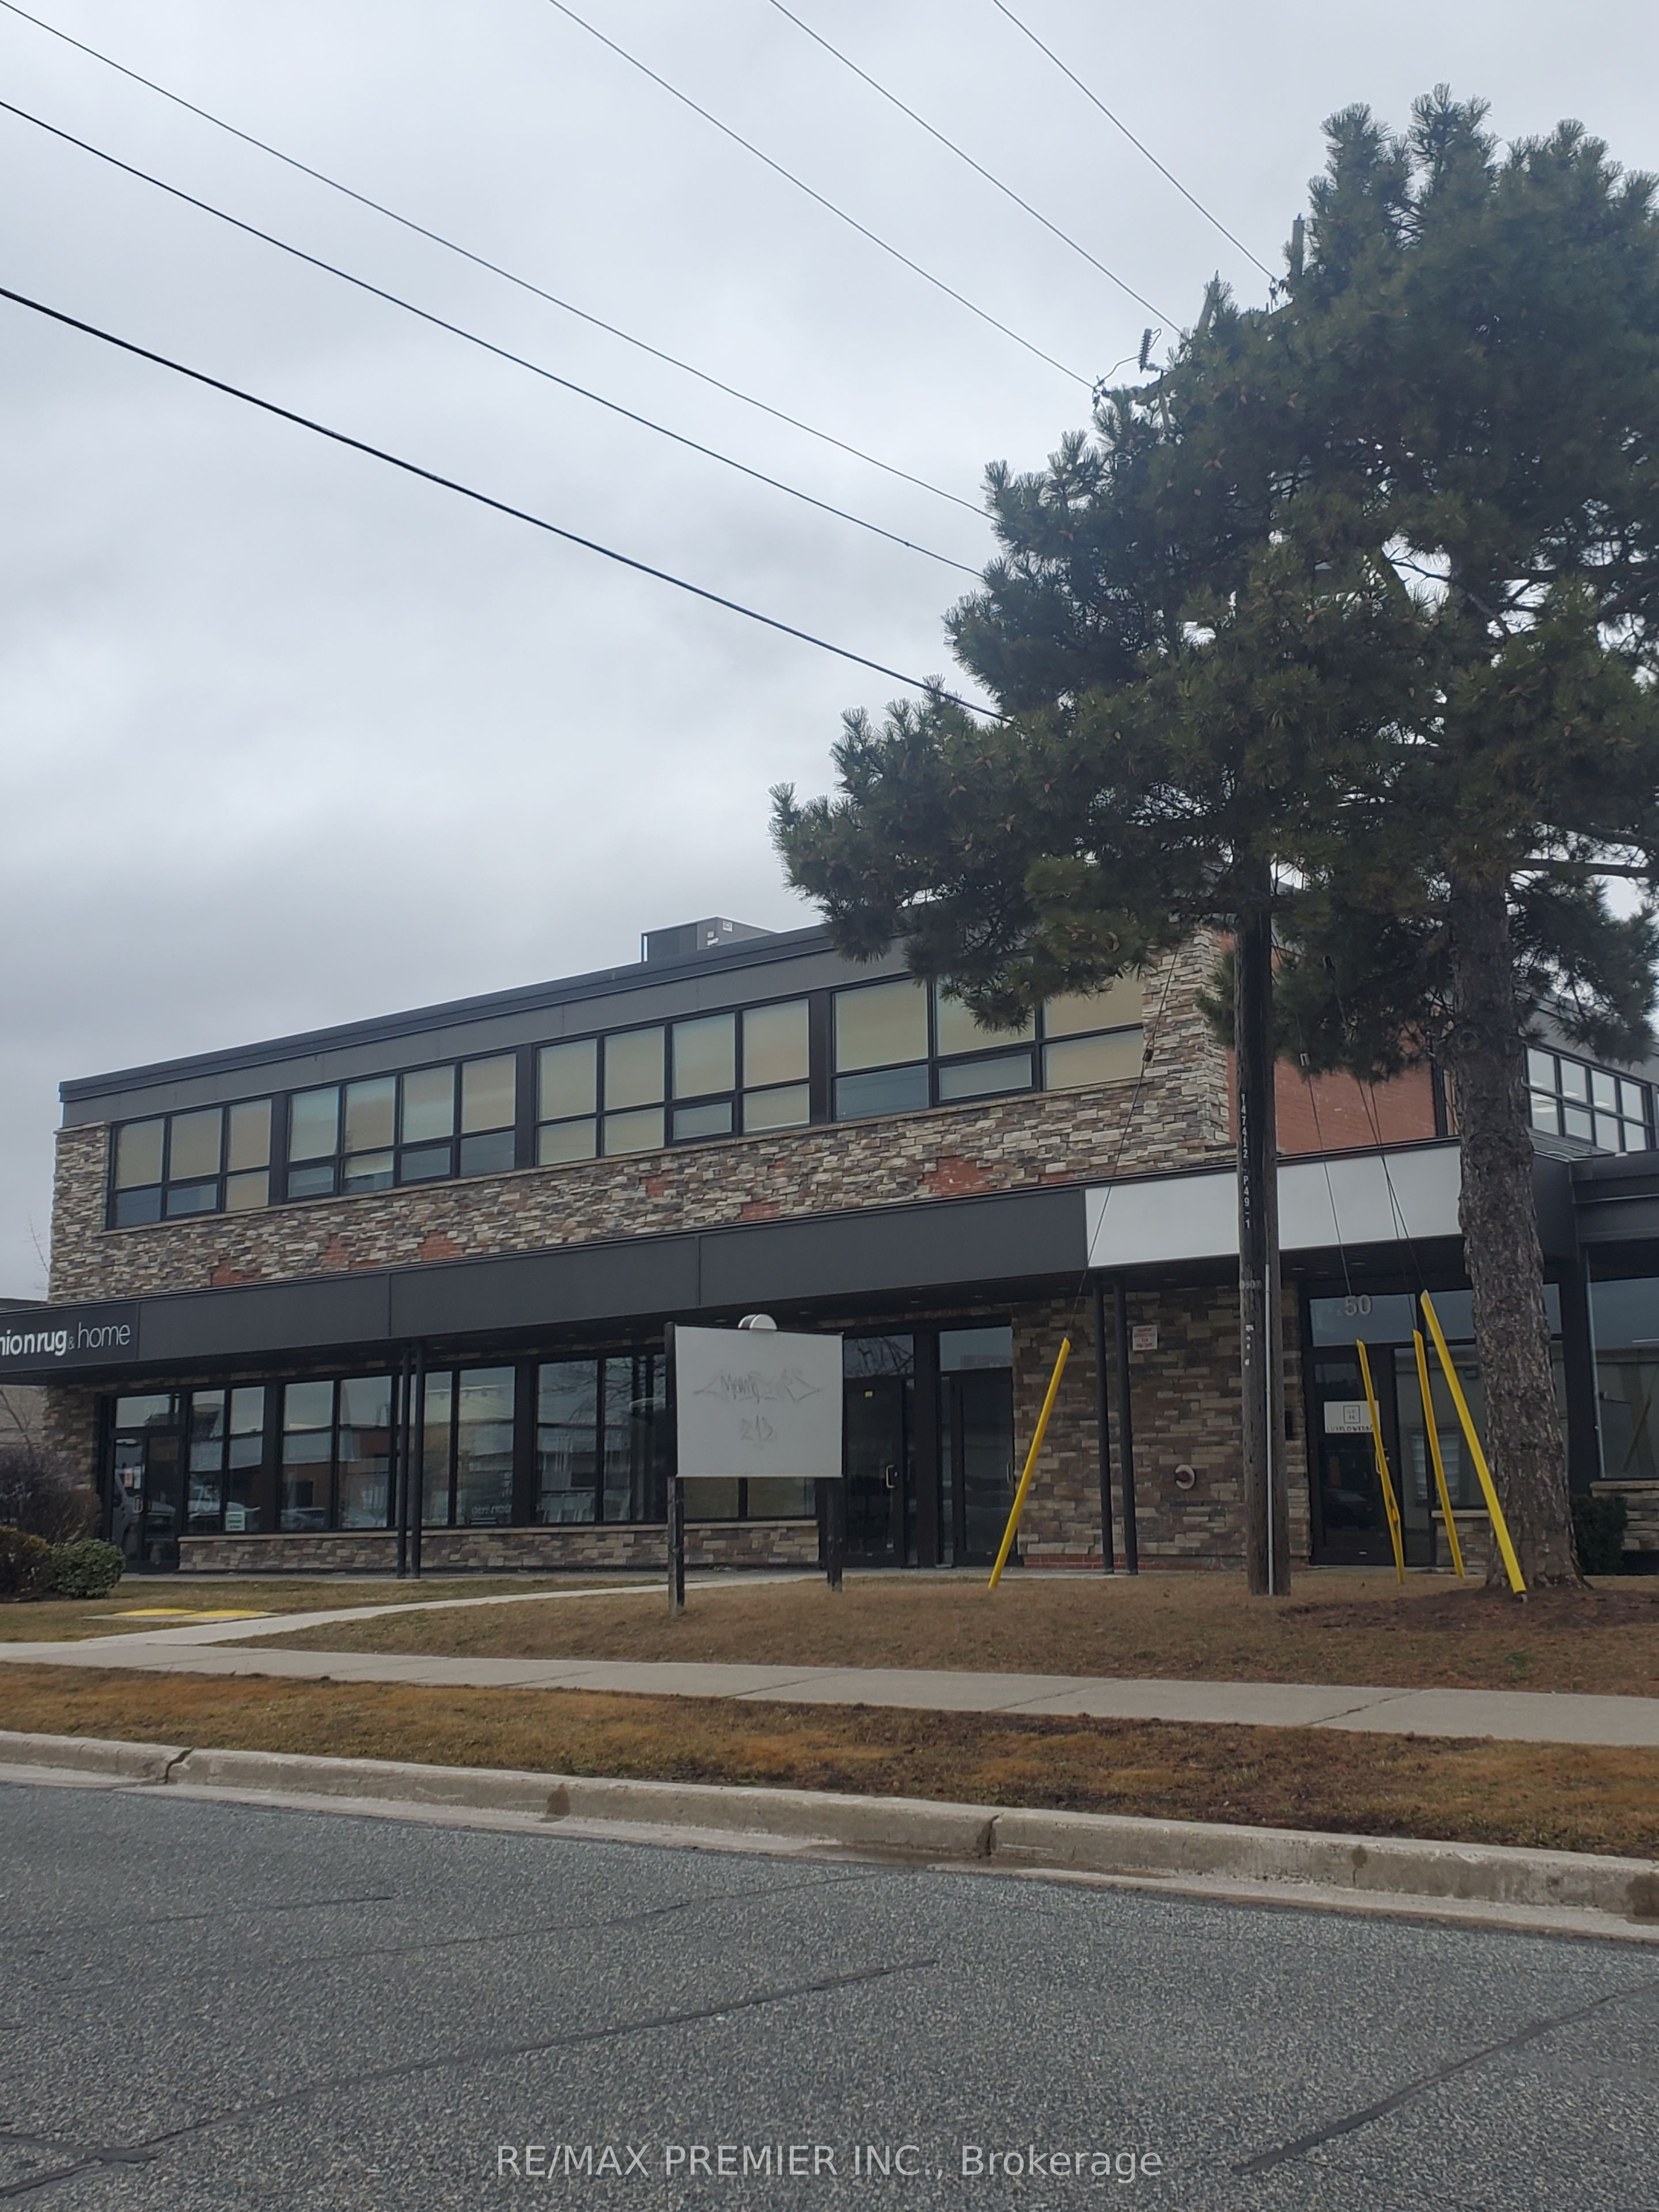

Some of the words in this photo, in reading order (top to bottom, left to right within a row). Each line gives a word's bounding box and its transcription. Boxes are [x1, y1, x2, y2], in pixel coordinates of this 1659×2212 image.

[1344, 1294, 1372, 1316] 50
[68, 1336, 75, 1350] &
[77, 1321, 131, 1349] home
